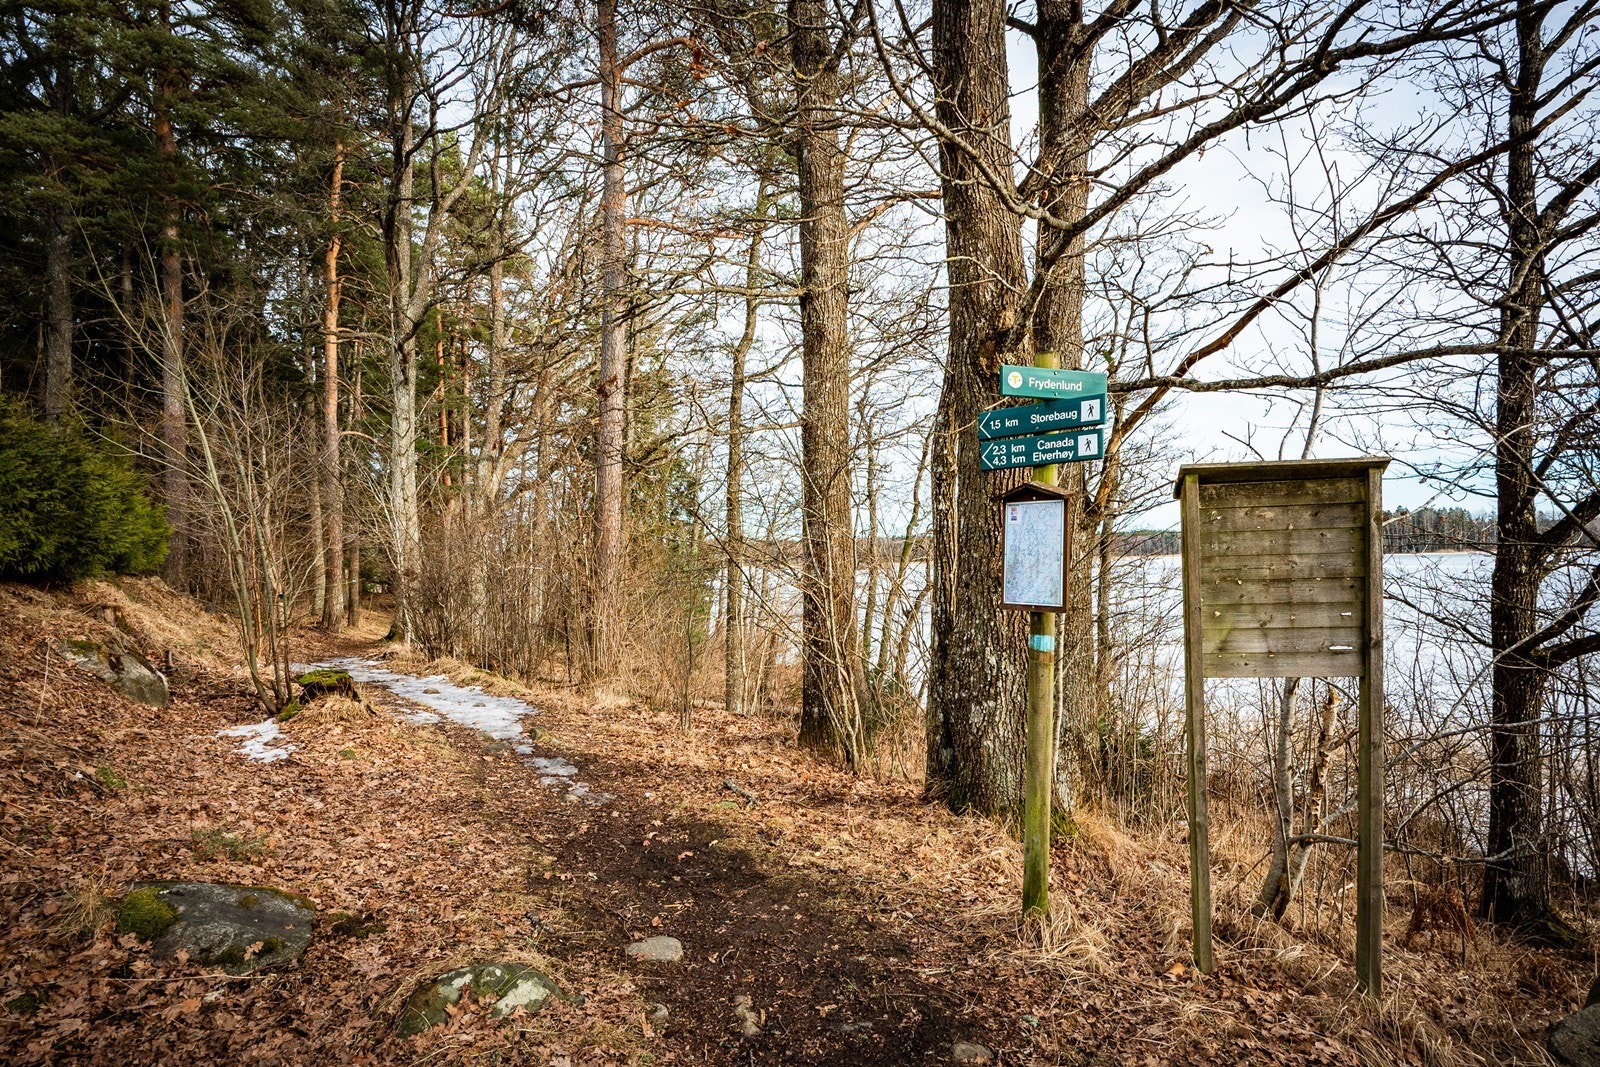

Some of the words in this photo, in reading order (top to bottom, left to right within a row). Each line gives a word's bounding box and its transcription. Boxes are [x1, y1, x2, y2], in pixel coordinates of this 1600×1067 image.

[1028, 378, 1083, 391] Frydenlund
[990, 421, 1001, 430] 1,5
[1005, 418, 1019, 427] km
[1030, 410, 1078, 424] Storebaug
[992, 445, 1007, 455] 2,3
[1011, 444, 1025, 453] km
[1037, 438, 1075, 450] Canada
[992, 456, 1007, 466] 4,3
[1011, 455, 1026, 464] km
[1032, 451, 1075, 462] Elverhøy
